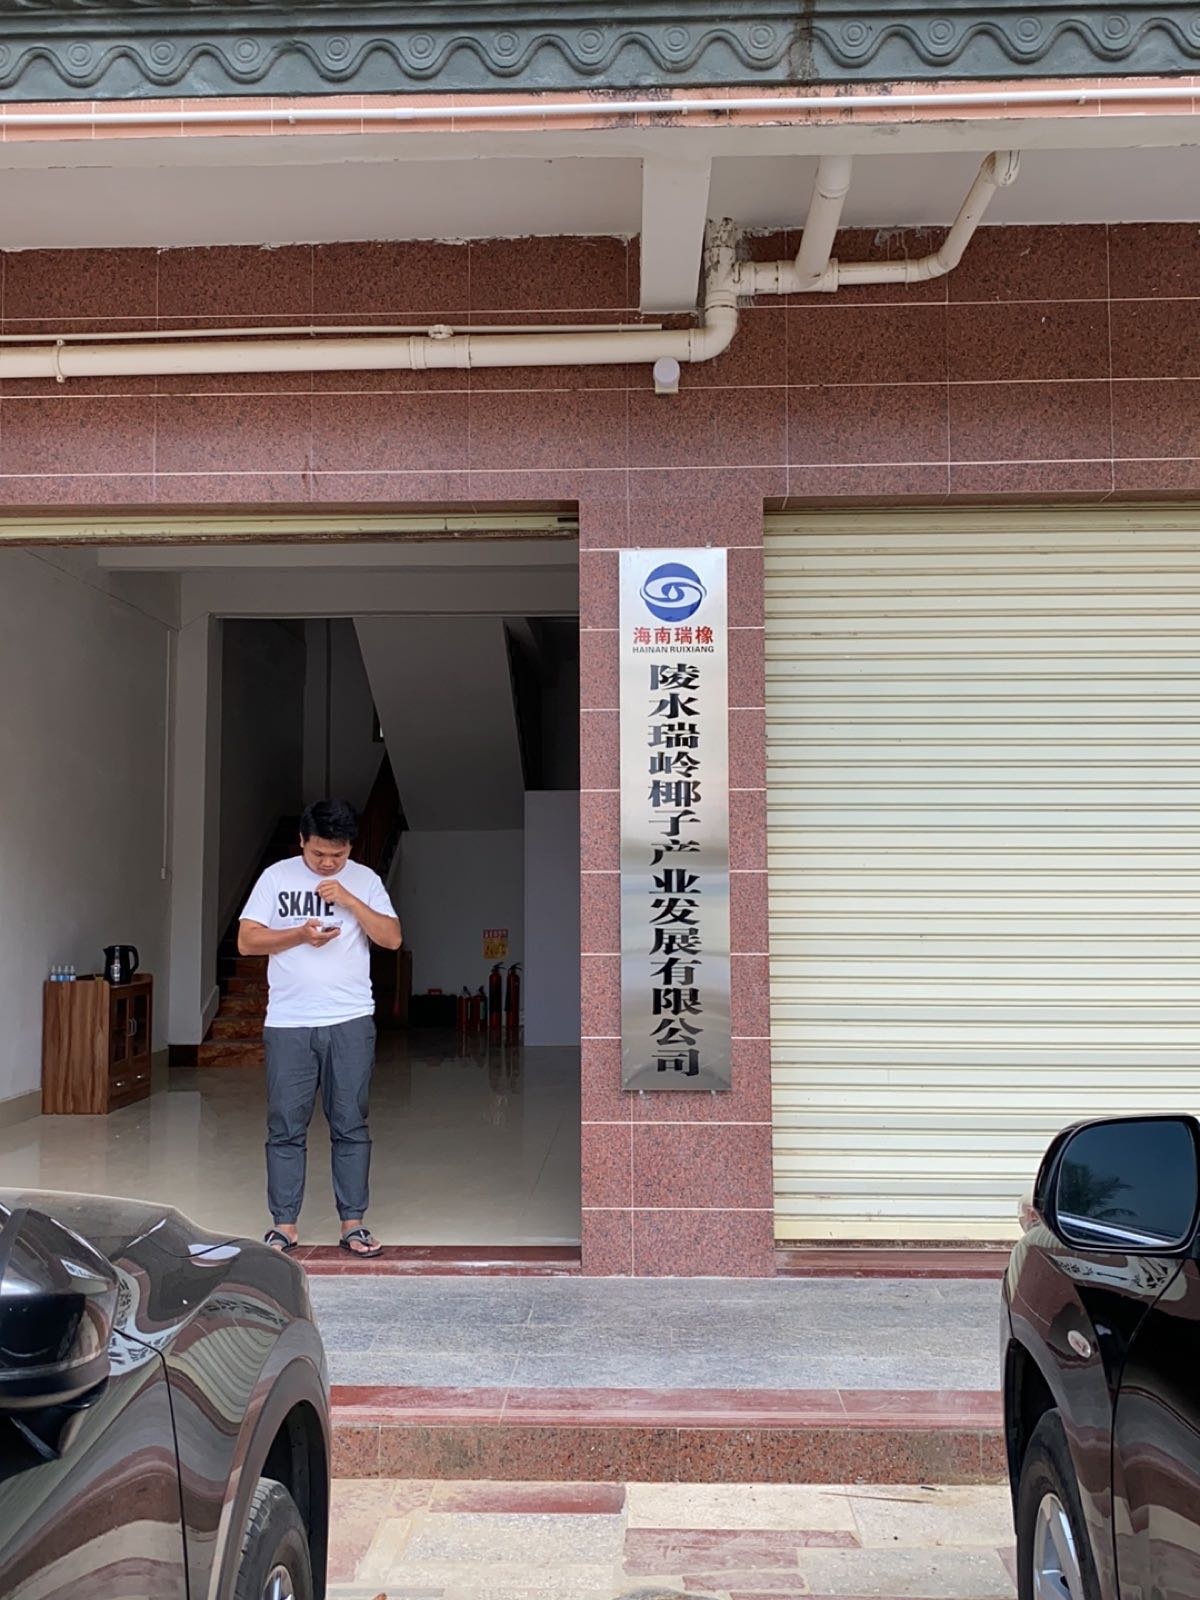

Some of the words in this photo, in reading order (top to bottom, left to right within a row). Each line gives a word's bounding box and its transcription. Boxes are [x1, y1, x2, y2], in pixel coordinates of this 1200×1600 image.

[633, 626, 714, 645] 海南瑞橡
[669, 645, 714, 653] RUIXIANG
[648, 663, 703, 1077] 陵水瑞岭椰子产业发展有限公司
